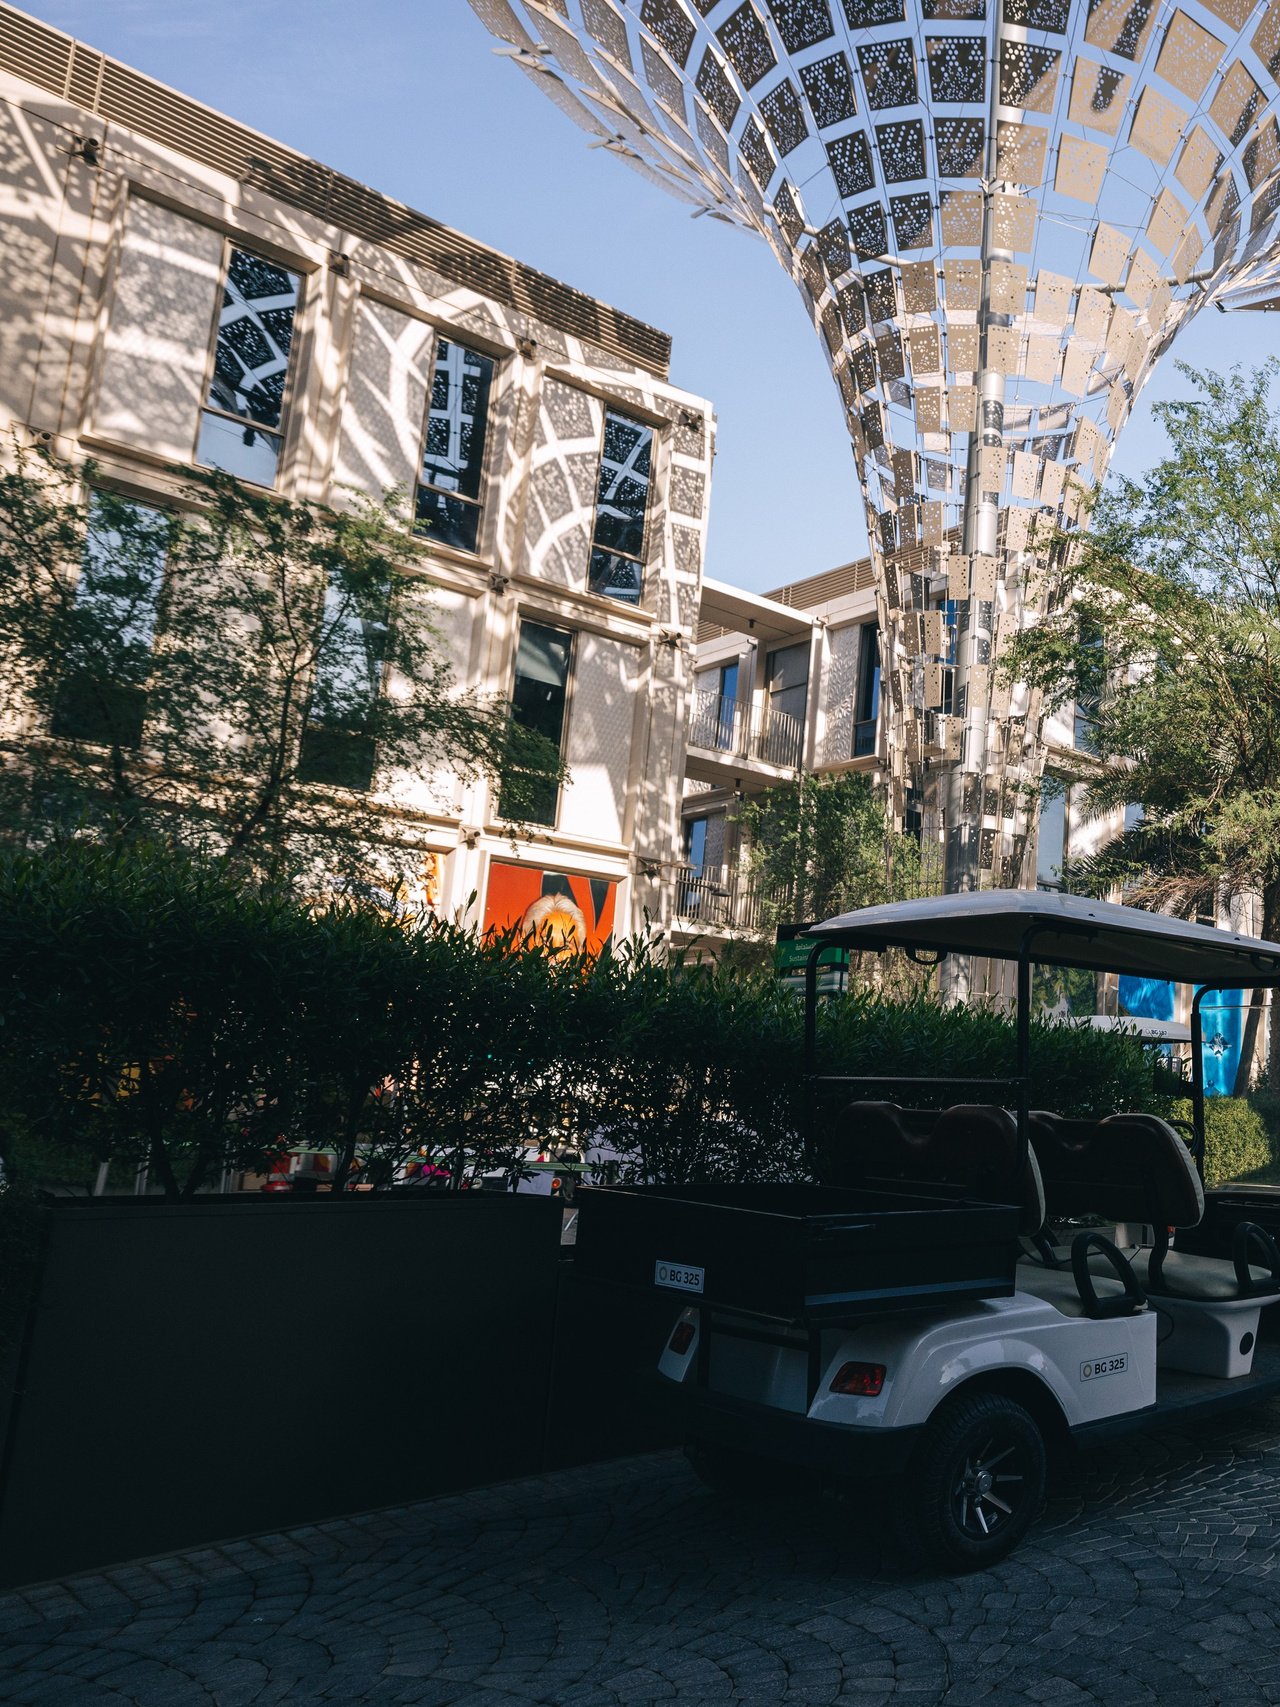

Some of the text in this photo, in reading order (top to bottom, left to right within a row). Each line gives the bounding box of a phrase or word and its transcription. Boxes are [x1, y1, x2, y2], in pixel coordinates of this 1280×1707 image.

[670, 1269, 700, 1286] BG 325
[1094, 1358, 1125, 1374] BG 325
